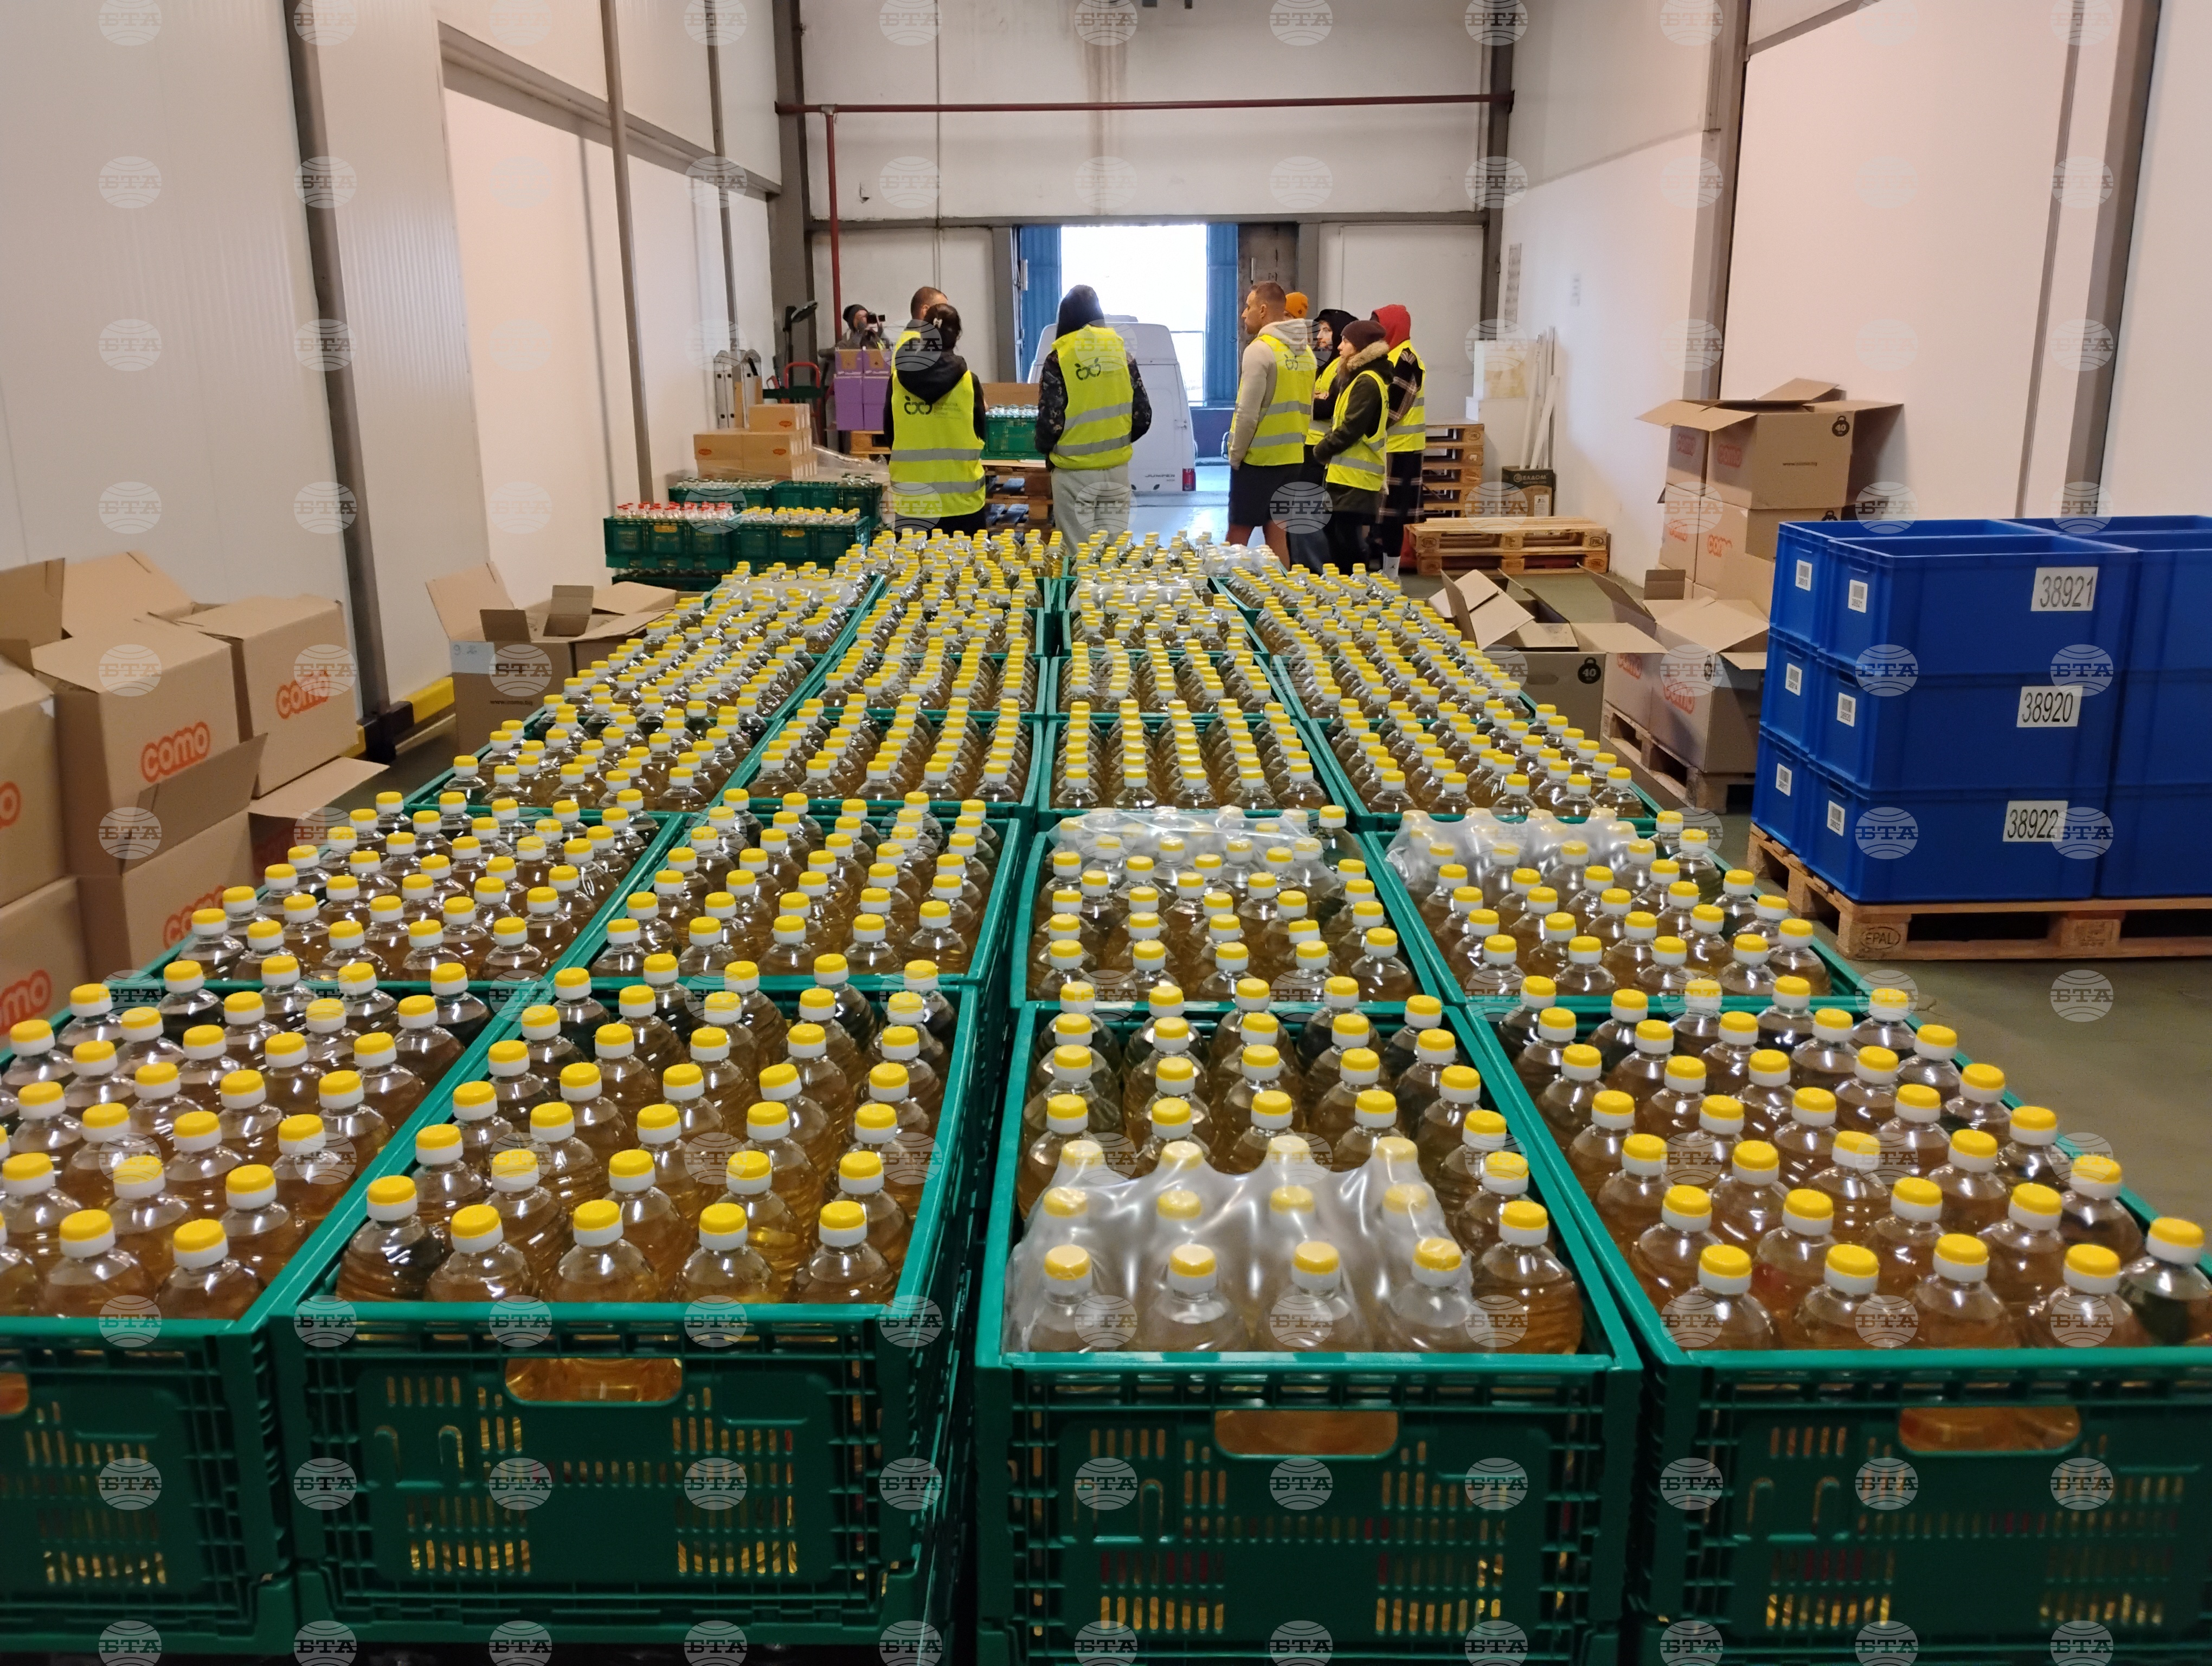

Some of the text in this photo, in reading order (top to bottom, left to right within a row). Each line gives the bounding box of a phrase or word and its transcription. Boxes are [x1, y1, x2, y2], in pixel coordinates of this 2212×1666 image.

[2040, 575, 2093, 607] 38921
[1582, 668, 1597, 677] 40
[276, 670, 330, 719] como
[2022, 692, 2073, 722] 38920
[142, 721, 210, 782] como
[2007, 809, 2058, 838] 38922
